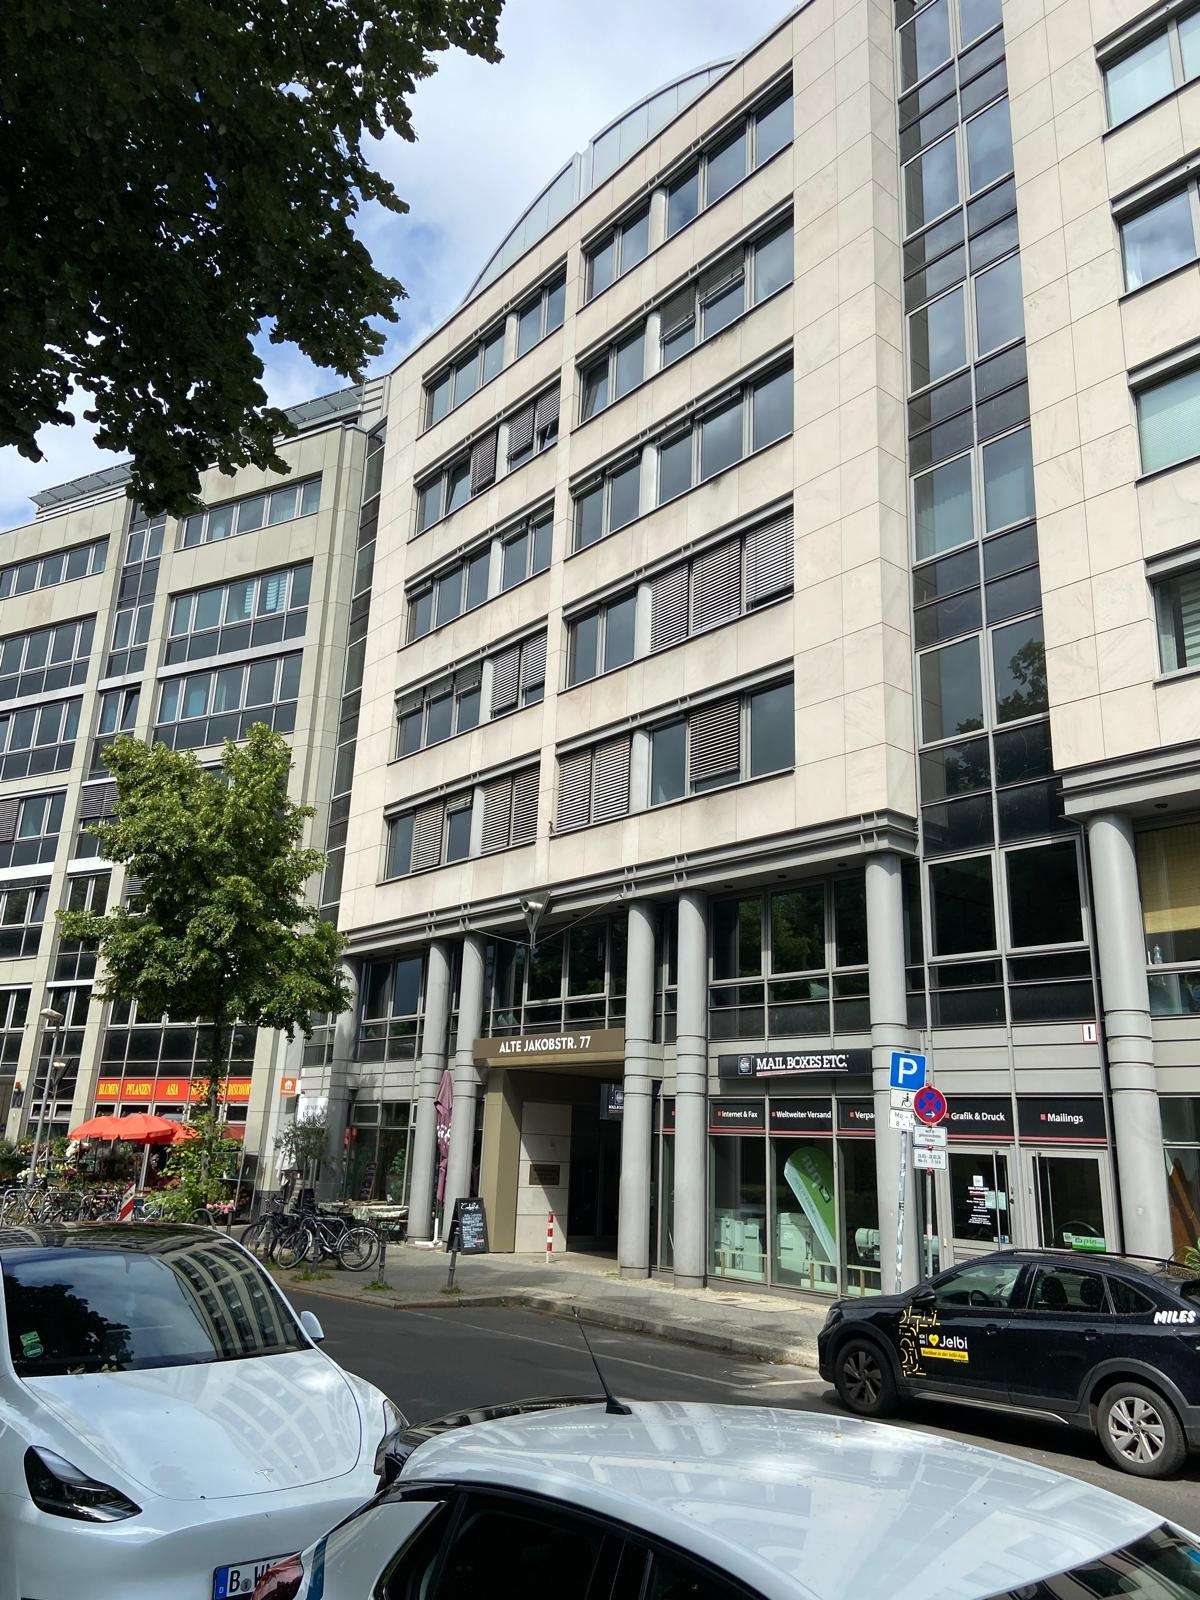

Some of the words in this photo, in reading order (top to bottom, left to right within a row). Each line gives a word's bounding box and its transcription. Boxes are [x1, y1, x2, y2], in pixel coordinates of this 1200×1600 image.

[499, 1041, 522, 1053] ALTE
[524, 1037, 577, 1051] JAKOBSTR.
[580, 1036, 591, 1048] 77
[756, 1058, 785, 1070] MAIL
[787, 1056, 821, 1069] BOXES
[822, 1055, 847, 1068] ETC.
[898, 1057, 917, 1084] P
[99, 1084, 119, 1095] BLUMEN
[126, 1084, 152, 1095] PFLANZEN
[166, 1084, 178, 1095] ASIA
[776, 1110, 806, 1118] Weltweiter
[807, 1110, 831, 1118] Versand
[951, 1112, 974, 1121] Grafik
[975, 1112, 981, 1120] &
[982, 1112, 1005, 1121] Druck
[1047, 1113, 1083, 1124] Mailings
[1153, 1310, 1196, 1324] MILES
[940, 1335, 967, 1349] Jelbi
[230, 1570, 240, 1592] B
